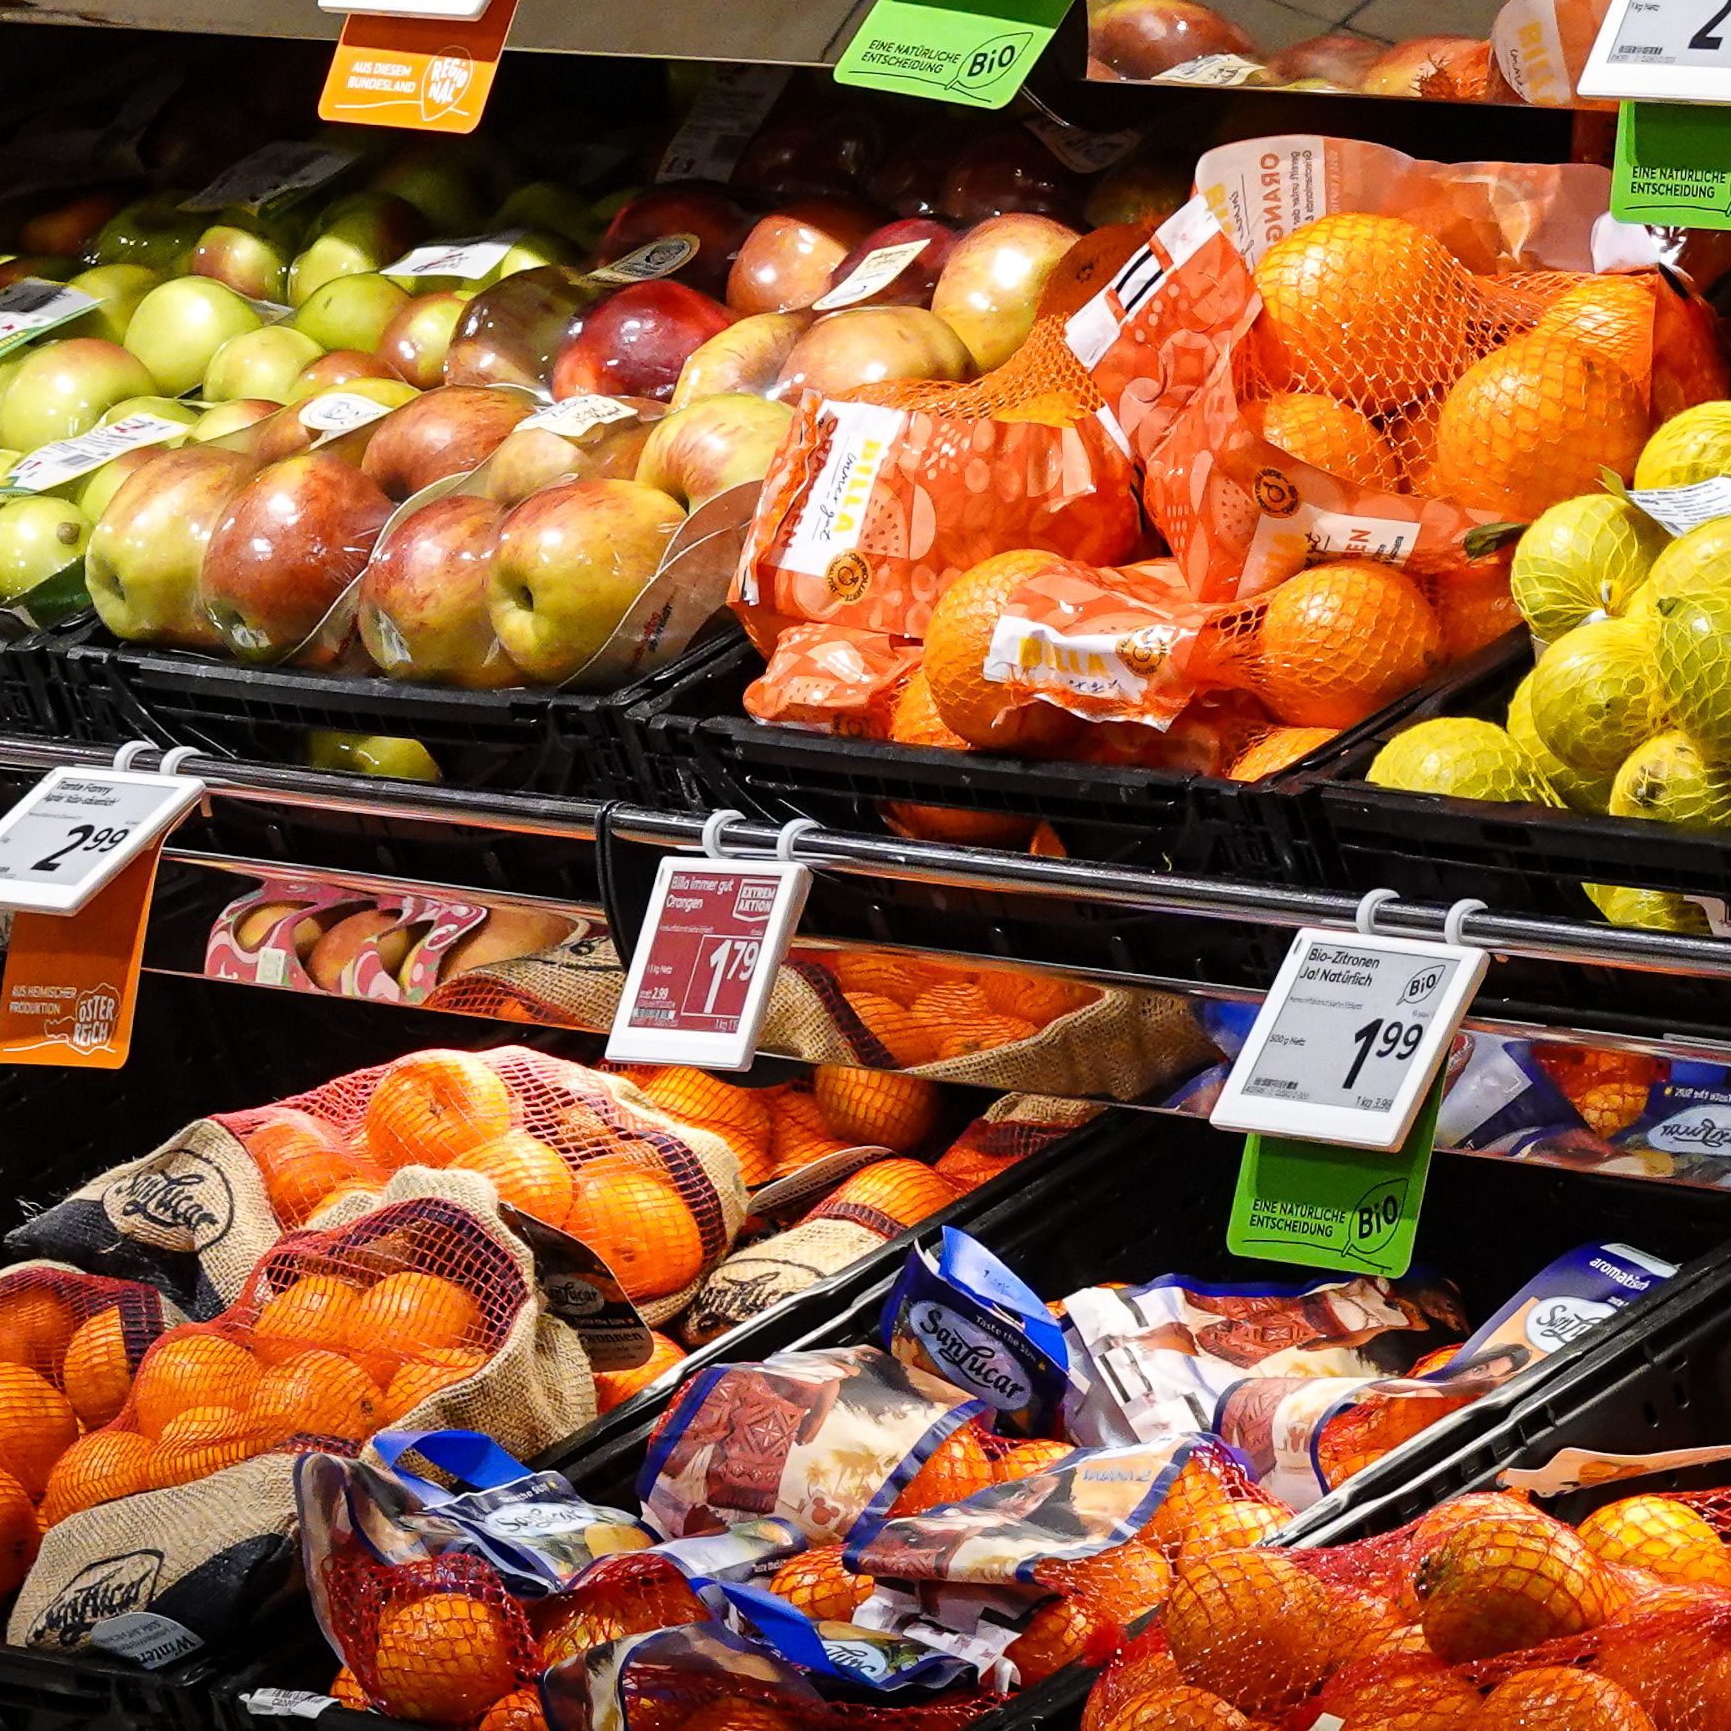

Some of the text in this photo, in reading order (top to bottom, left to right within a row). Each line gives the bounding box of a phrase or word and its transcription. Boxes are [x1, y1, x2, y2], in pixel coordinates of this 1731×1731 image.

[861, 51, 944, 75] ENTSCHEIDUNG
[869, 38, 962, 65] EINE NATÜRLICHE
[966, 44, 1016, 78] BiO
[351, 62, 413, 78] AUS DIESEM
[346, 75, 416, 94] BUNDESLAND
[1631, 164, 1728, 184] EINE NATÜRLICHE
[1629, 181, 1716, 200] ENTSCHEIDUNG
[831, 438, 883, 537] BILLA
[741, 882, 775, 900] EXTREM
[665, 894, 704, 913] Orangen
[738, 899, 773, 914] AKTION
[1308, 949, 1381, 971] Bio-Zitronen
[1299, 966, 1374, 989] Ja! Natürlich
[1409, 973, 1439, 999] BiO
[8, 1001, 61, 1015] PRODUKTION
[78, 994, 116, 1022] ÖSTER
[1252, 1199, 1346, 1223] EINE NATÜRLICHE
[1358, 1194, 1398, 1239] BiO
[1249, 1214, 1333, 1238] ENTSCHEIDUNG
[919, 1307, 1025, 1400] SanLucar
[497, 1507, 583, 1533] SanLucar
